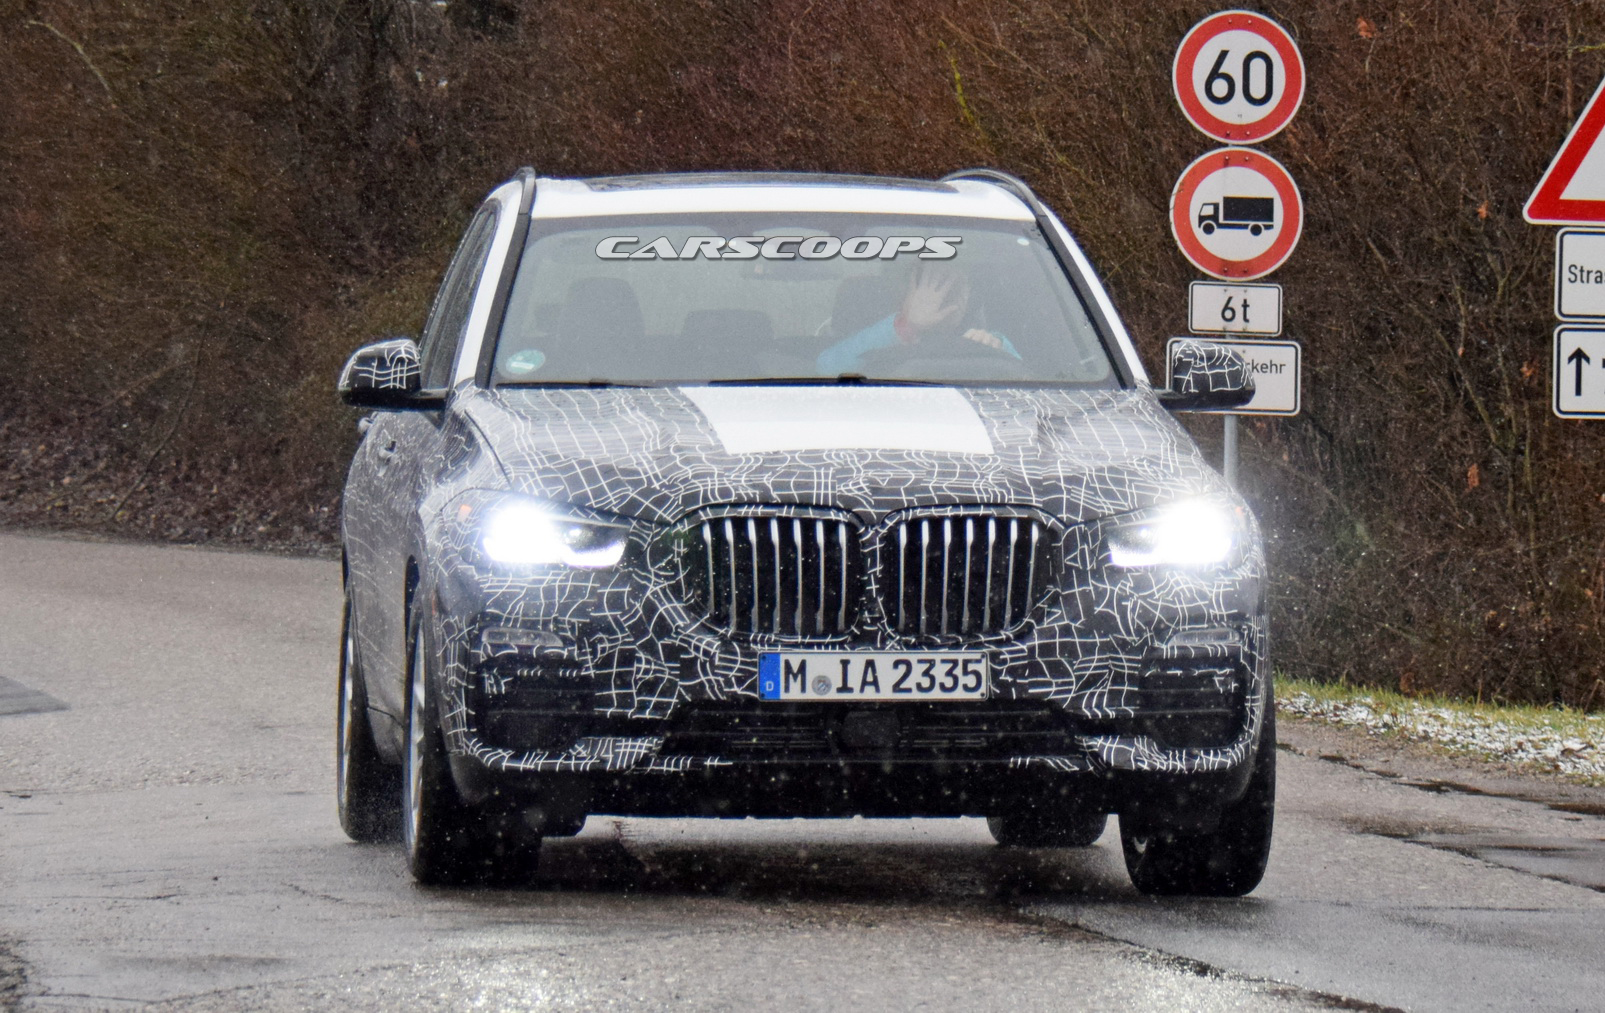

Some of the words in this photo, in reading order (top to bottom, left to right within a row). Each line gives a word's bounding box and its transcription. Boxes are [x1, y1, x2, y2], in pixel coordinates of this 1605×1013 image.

[1204, 50, 1273, 107] 60
[1568, 264, 1605, 284] Stra
[783, 659, 807, 694] M
[836, 659, 880, 693] IA
[892, 659, 983, 693] 2335
